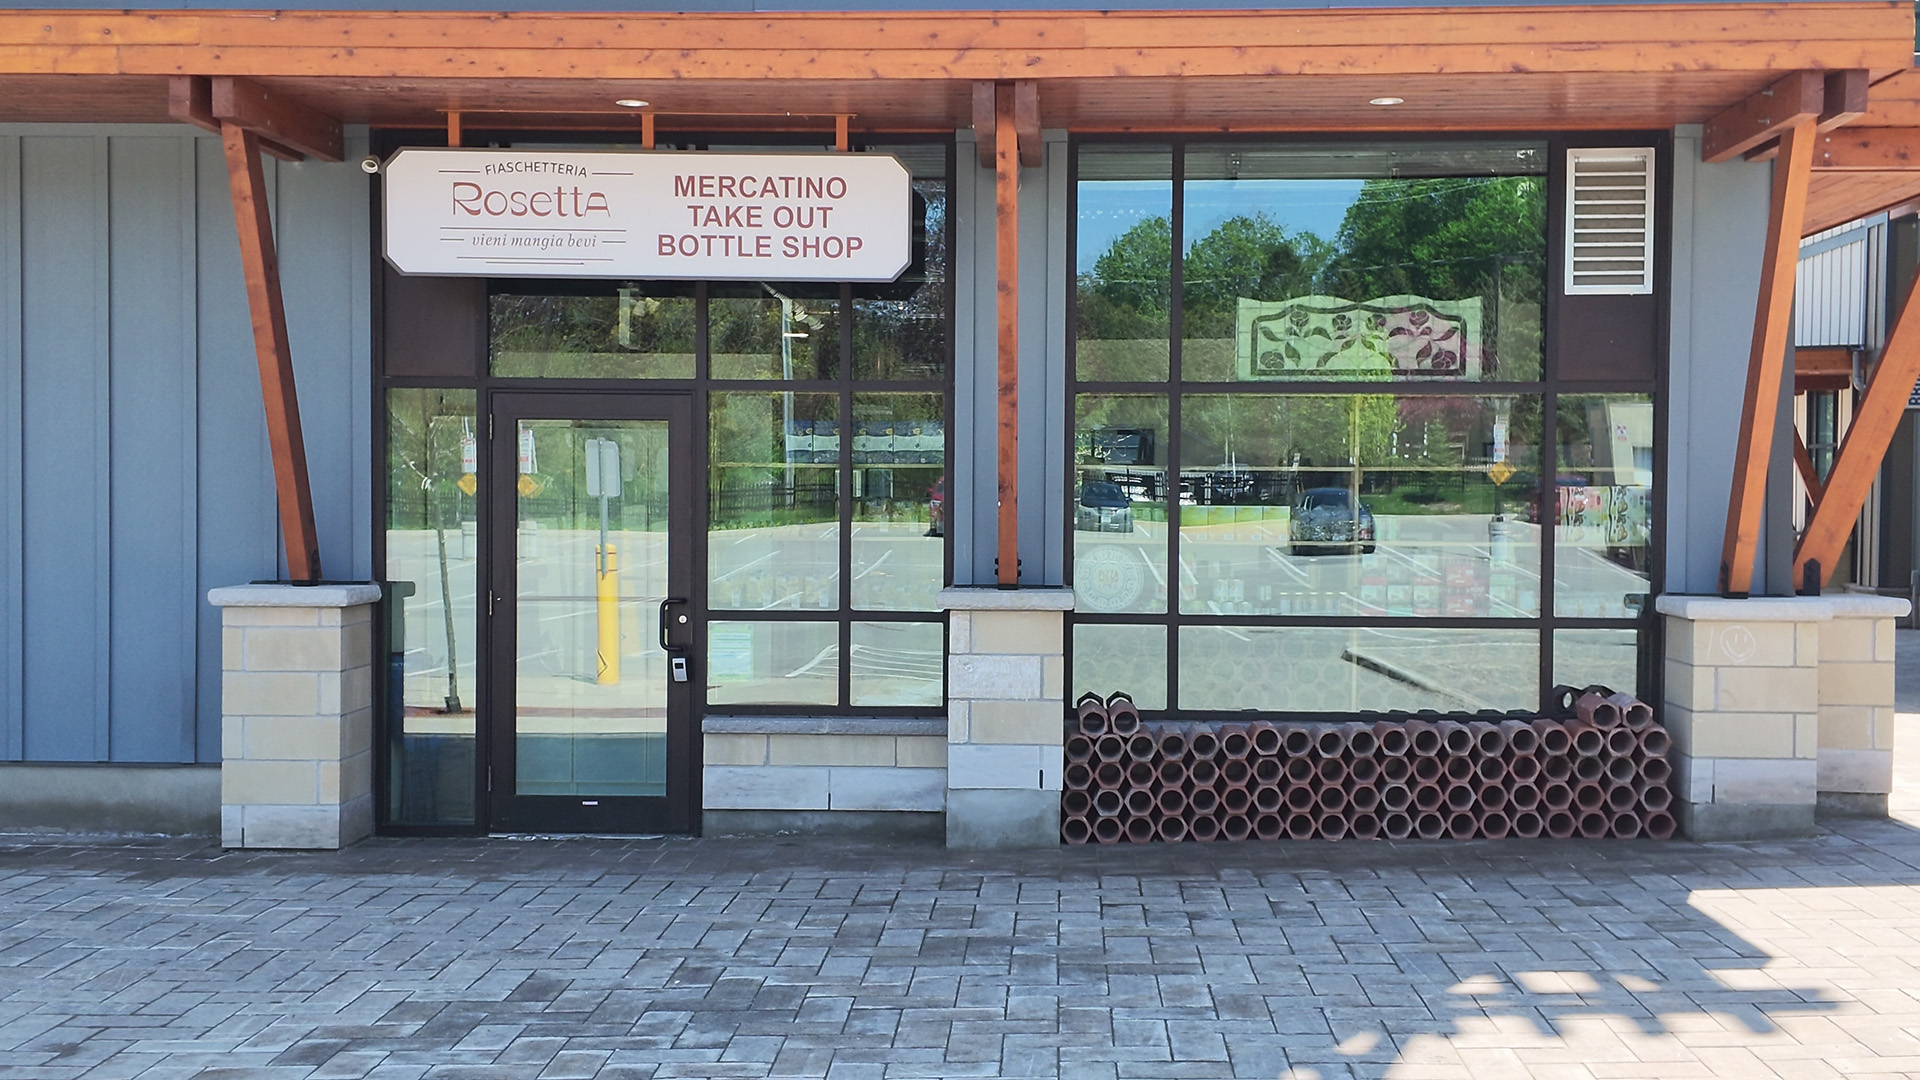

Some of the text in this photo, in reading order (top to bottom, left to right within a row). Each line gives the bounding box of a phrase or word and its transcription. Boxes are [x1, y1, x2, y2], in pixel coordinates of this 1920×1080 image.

[485, 161, 588, 178] FIASCHETTERIA
[674, 175, 848, 199] MERCATINO
[687, 205, 834, 229] TAKE OUT
[472, 233, 598, 251] vieni mangia bevi
[658, 234, 864, 259] BOTTLE SHOP
